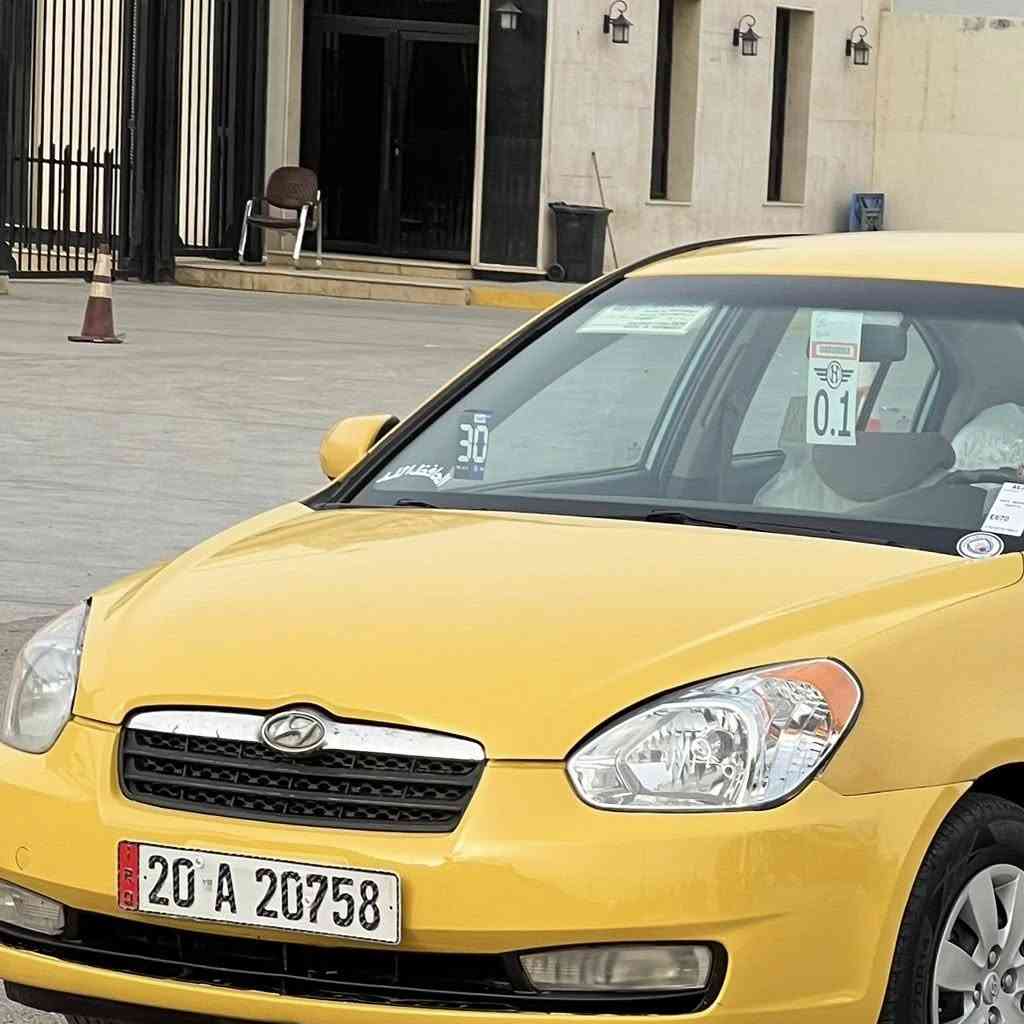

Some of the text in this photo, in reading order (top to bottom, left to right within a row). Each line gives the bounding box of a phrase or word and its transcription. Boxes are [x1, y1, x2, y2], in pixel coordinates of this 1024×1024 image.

[813, 388, 851, 437] 0.1
[457, 423, 488, 463] 30
[147, 854, 381, 932] 20 A 20758
